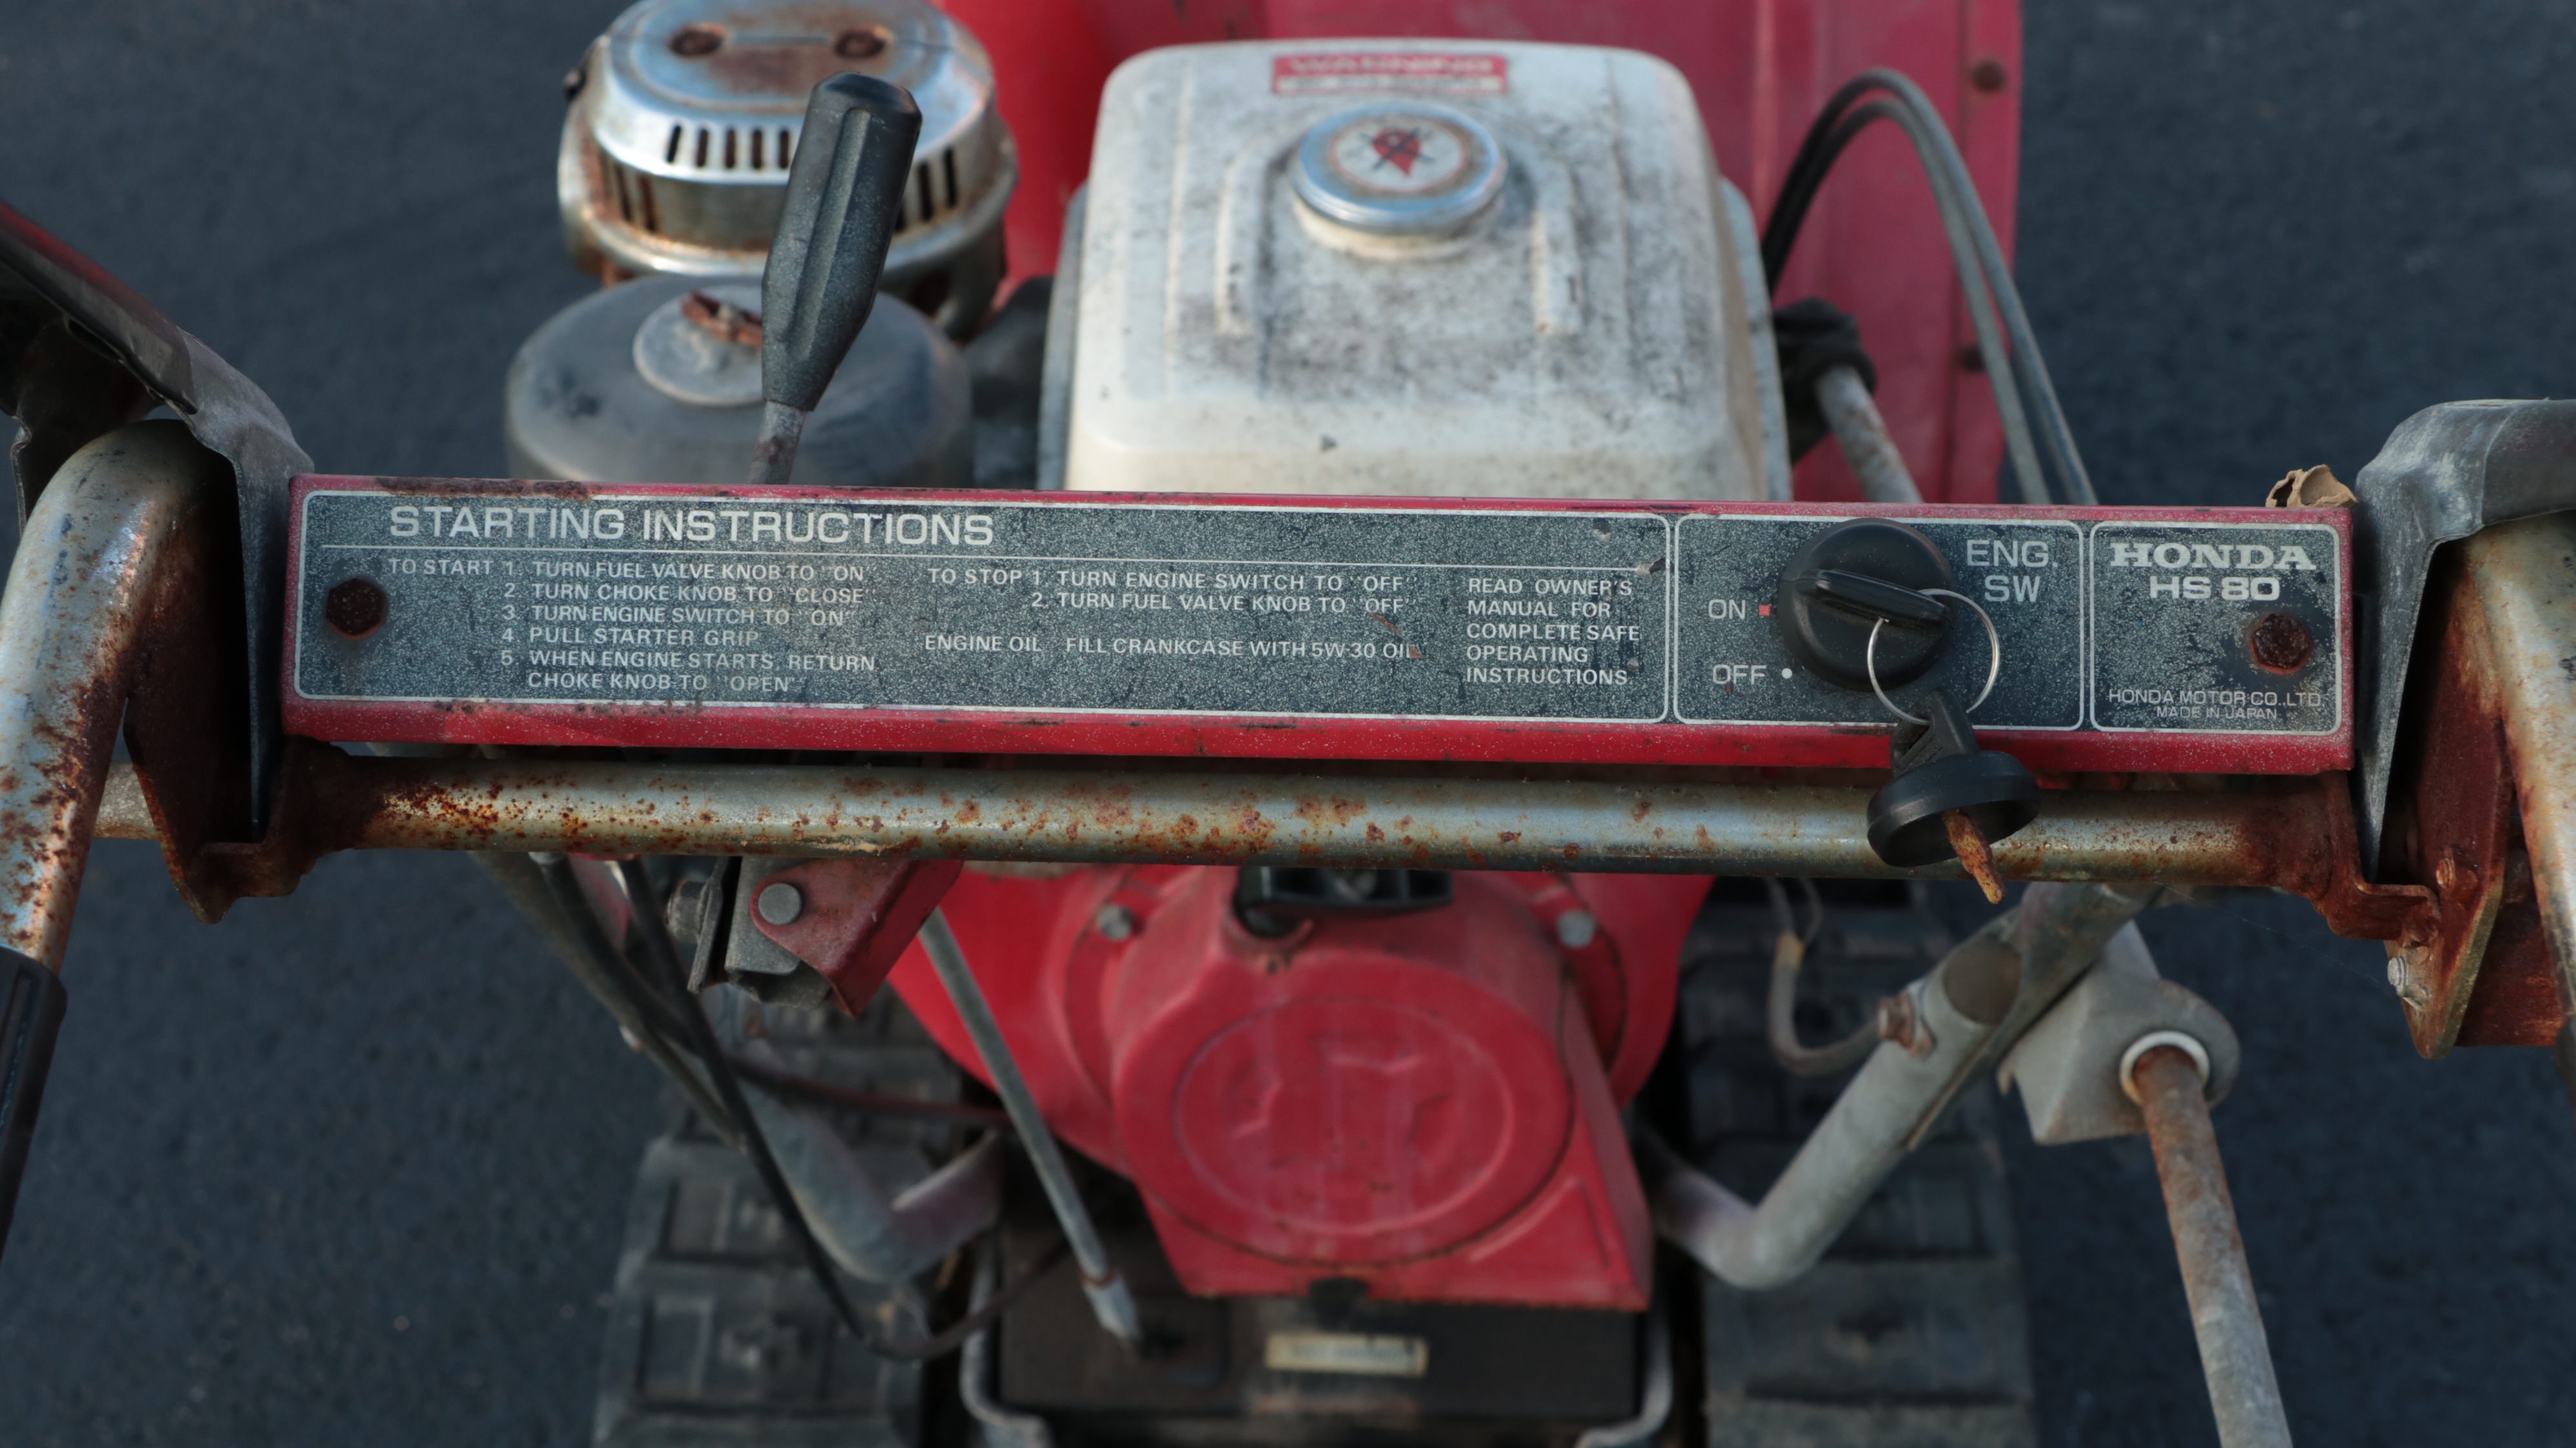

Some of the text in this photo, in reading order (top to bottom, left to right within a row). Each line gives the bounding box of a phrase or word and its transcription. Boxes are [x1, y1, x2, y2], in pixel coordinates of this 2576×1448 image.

[391, 506, 993, 546] STARTING INSTRUCTIONS
[1966, 540, 2058, 568] ENG.
[2110, 542, 2317, 570] HONDA
[389, 559, 416, 574] TO
[424, 559, 494, 575] START
[532, 562, 589, 577] TURN
[596, 562, 645, 578] FUEL
[652, 563, 714, 579] VALVE
[722, 564, 780, 580] KNOB
[787, 565, 814, 580] TO
[928, 568, 956, 584] TO
[965, 569, 1022, 584] STOP
[1057, 571, 1116, 587] TURN
[1127, 572, 1206, 588] ENGINE
[1215, 573, 1304, 590] SWITCH
[1314, 575, 1342, 591] TO
[1468, 578, 1633, 595] READ OWNER'S
[1984, 575, 2041, 602] SW
[2150, 576, 2280, 601] HS 80
[532, 583, 588, 599] TURN
[598, 584, 669, 601] CHOKE
[679, 586, 736, 601] KNOB
[745, 587, 773, 602] TO
[1057, 593, 1114, 608] TURN
[1122, 593, 1172, 609] FUEL
[1179, 595, 1245, 610] VALVE
[1252, 596, 1311, 612] KNOB
[1318, 597, 1346, 612] TO
[1468, 600, 1611, 617] MANUAL FOR
[1708, 599, 1746, 620] ON
[531, 605, 587, 621] TURN
[592, 606, 665, 623] ENGINE
[672, 607, 754, 624] SWITCH
[763, 610, 789, 624] TO
[530, 627, 585, 643] PULL
[594, 628, 694, 645] STARTER
[705, 630, 758, 646] GRIP
[1467, 623, 1640, 641] COMPLETE SAFE
[925, 635, 1002, 651] ENGINE
[1009, 636, 1042, 652] OIL
[1067, 638, 1106, 653] FILL
[1113, 639, 1243, 655] CRANKCASE
[1250, 641, 1305, 657] WITH
[1466, 645, 1588, 662] OPERATING
[530, 650, 595, 666] WHEN
[602, 651, 682, 666] ENGINE
[789, 655, 875, 671] RETURN
[528, 672, 603, 688] CHOKE
[610, 674, 671, 689] KNOB
[679, 675, 707, 690] TO
[1466, 668, 1627, 685] INSTRUCTIONS
[1713, 664, 1766, 685] OFF
[2109, 689, 2174, 704] HONDA
[2180, 690, 2246, 706] MOTOR
[2157, 706, 2277, 719] MADE IN JAPAN
